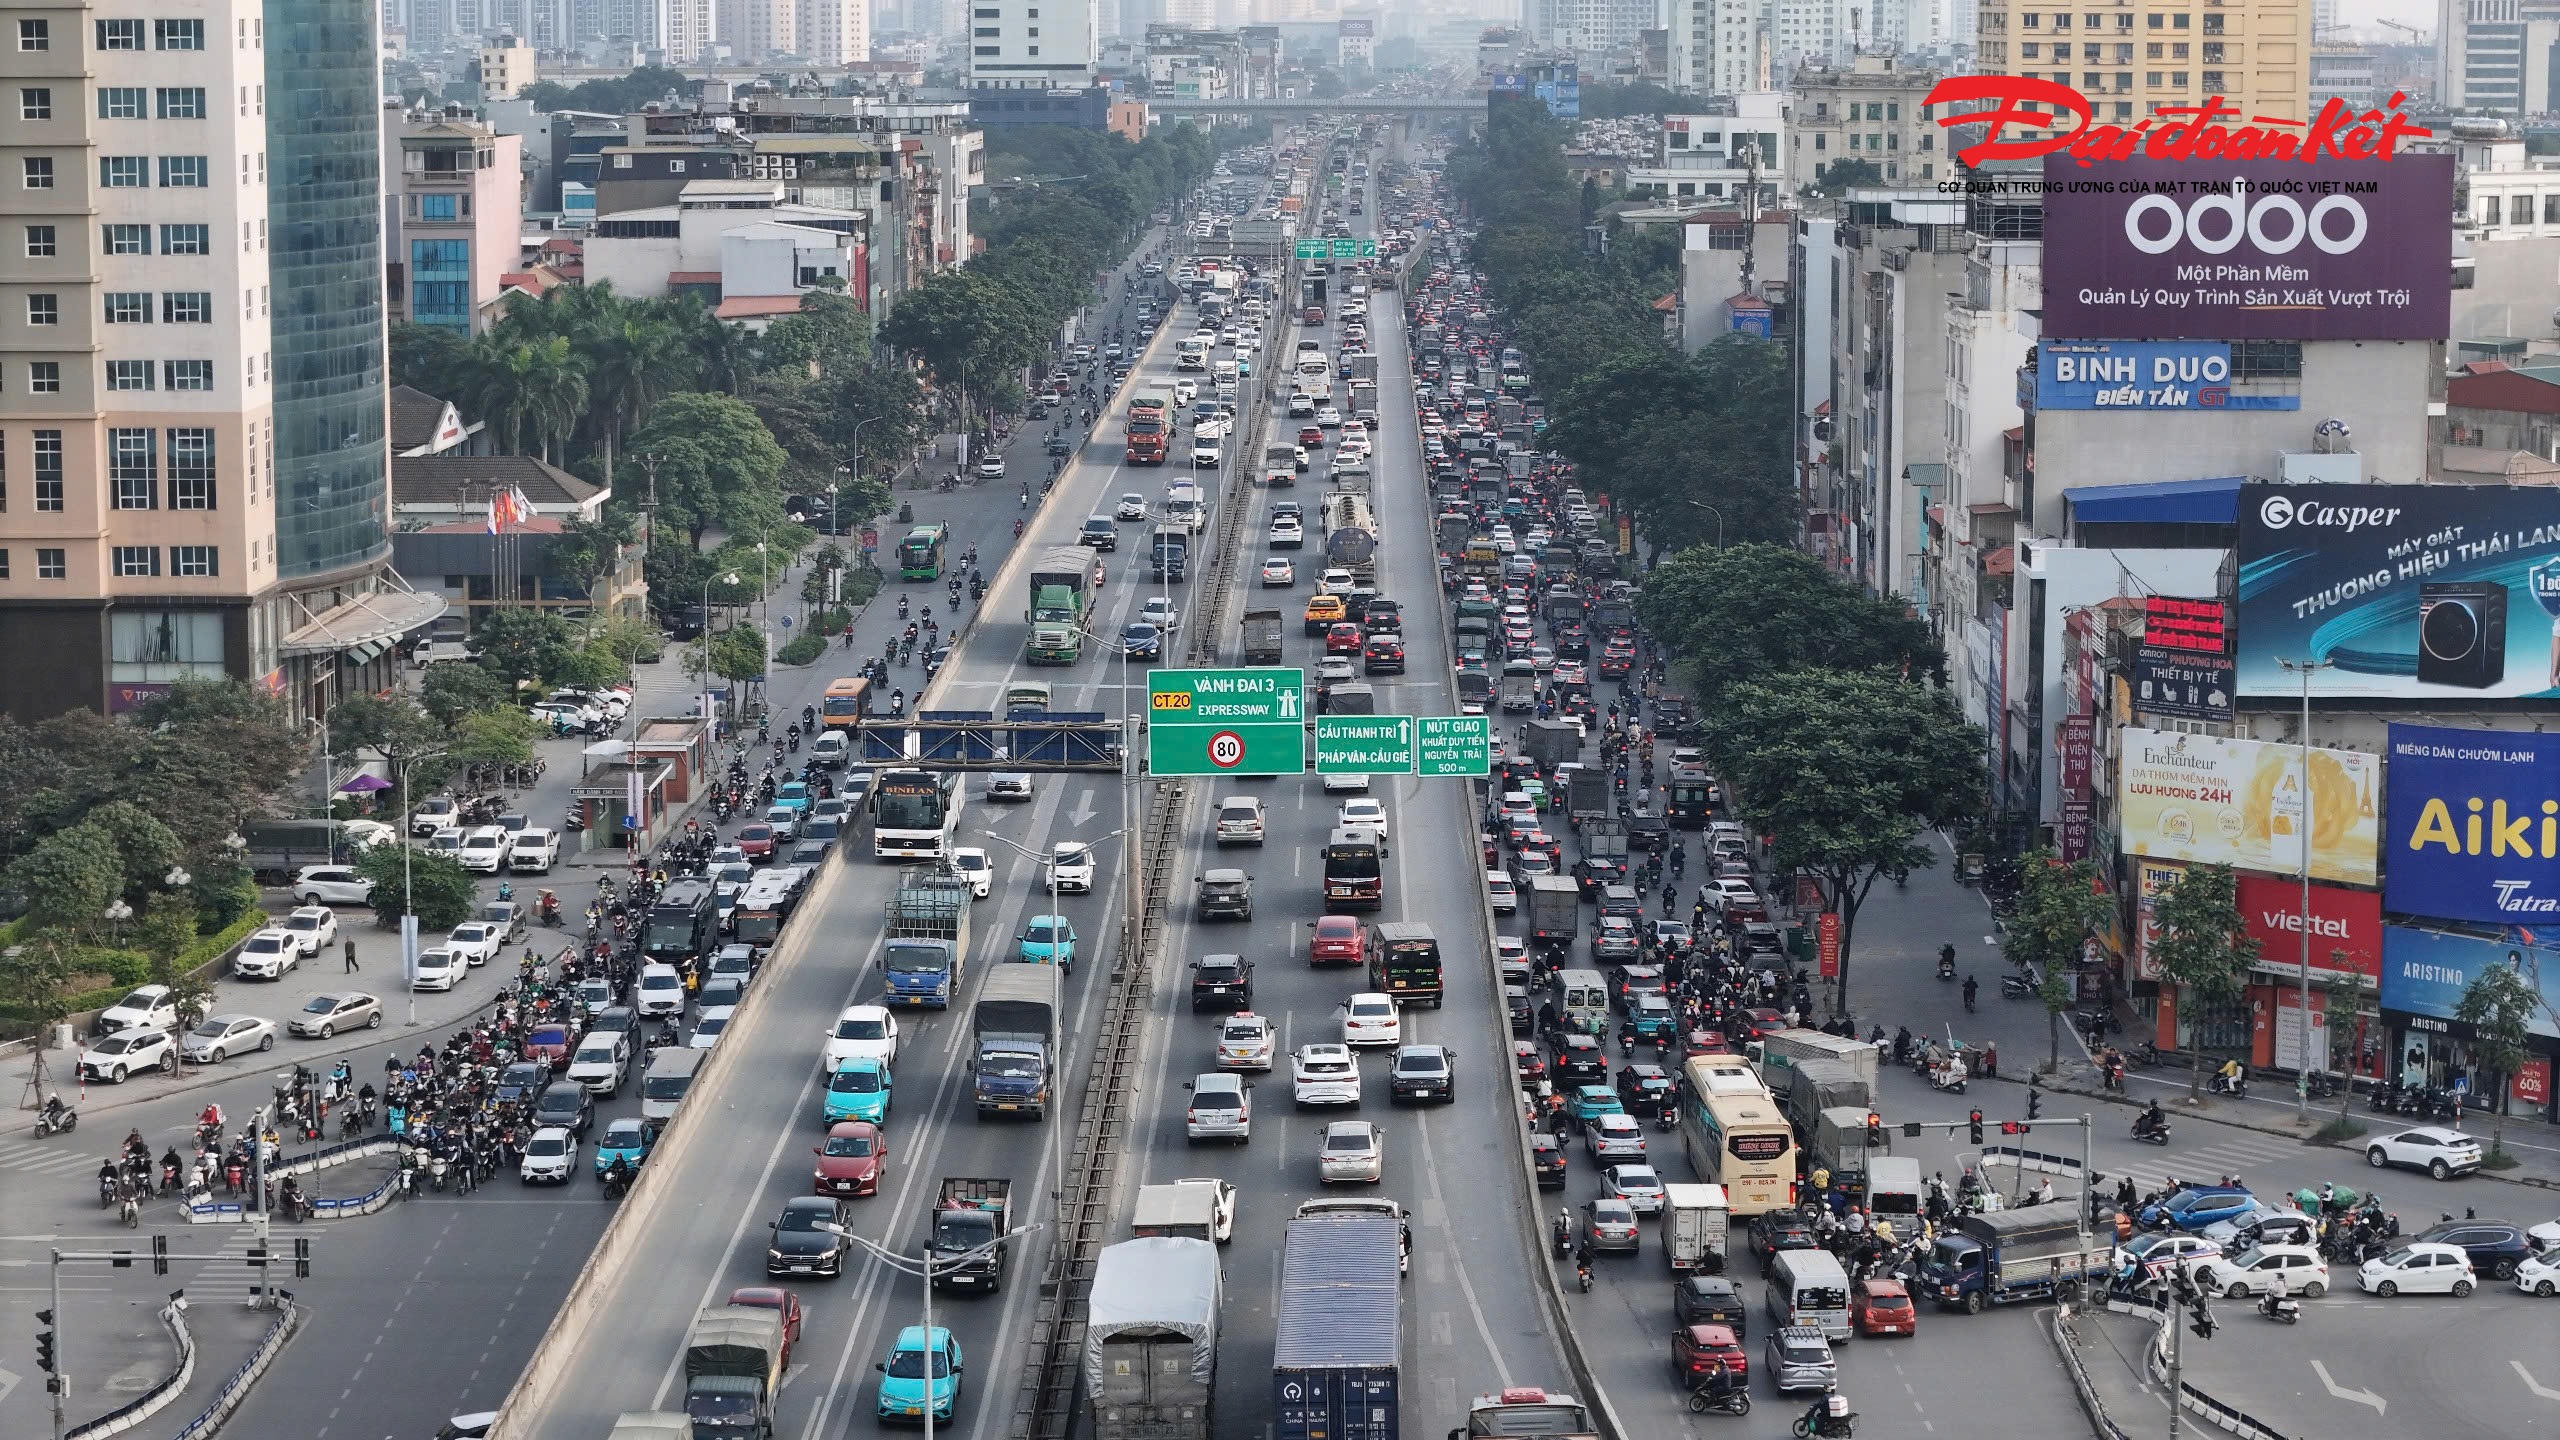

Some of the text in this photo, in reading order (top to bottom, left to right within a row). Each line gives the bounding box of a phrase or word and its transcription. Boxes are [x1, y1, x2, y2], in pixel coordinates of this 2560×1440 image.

[2125, 175, 2368, 255] odoo
[2176, 263, 2309, 284] Một Phần Mềm
[2078, 287, 2411, 309] Quản Lý Quy Trình Sản Xuất Vượt Trội
[2056, 355, 2229, 383] BINH DUO
[2095, 384, 2144, 406] BIẾN
[2148, 384, 2189, 406] TẦN
[2296, 500, 2401, 533] Casper
[2387, 526, 2465, 561] MÁY GIẶT
[2292, 523, 2560, 620] THƯƠNG HIỆU THÁI LAN
[2168, 653, 2211, 669] PHƯƠNG
[2151, 665, 2220, 684] THIẾT BỊ Y TẾ
[1193, 675, 1275, 693] VÀNH ĐAI 3
[1153, 694, 1191, 708] CT.20
[1198, 704, 1271, 716] EXPRESSWAY
[1341, 726, 1378, 739] THANH
[1379, 724, 1397, 739] TRÌ
[1426, 718, 1481, 734] NÚT GIAO
[1421, 734, 1485, 747] KHUẤT DUY TIẾN
[2068, 727, 2091, 742] BỆNH
[1216, 741, 1237, 757] 80
[1318, 748, 1346, 764] PHÁP
[1424, 746, 1459, 760] NGUYỄN
[2069, 741, 2089, 757] VIỆN
[2396, 742, 2535, 765] MIẾNG DÁN CHƯỜM LẠNH
[2069, 756, 2087, 771] THÚ
[2143, 745, 2217, 771] Enchanteur
[1438, 763, 1457, 773] 500
[2075, 774, 2080, 786] Y
[2132, 767, 2229, 789] DA THƠM MỀM MỊN
[885, 785, 915, 794] BÌNH
[2130, 782, 2233, 805] LƯU HƯƠNG 24H
[2065, 810, 2088, 826] BỆNH
[2066, 823, 2087, 838] VIỆN
[2409, 797, 2559, 859] Aiki
[2067, 835, 2085, 848] THÚ
[2492, 879, 2556, 912] Tatra
[2262, 909, 2351, 939] viettel
[2403, 961, 2463, 986] ARISTINO
[2411, 1016, 2448, 1033] ARISTINO
[2519, 1077, 2542, 1091] 60%
